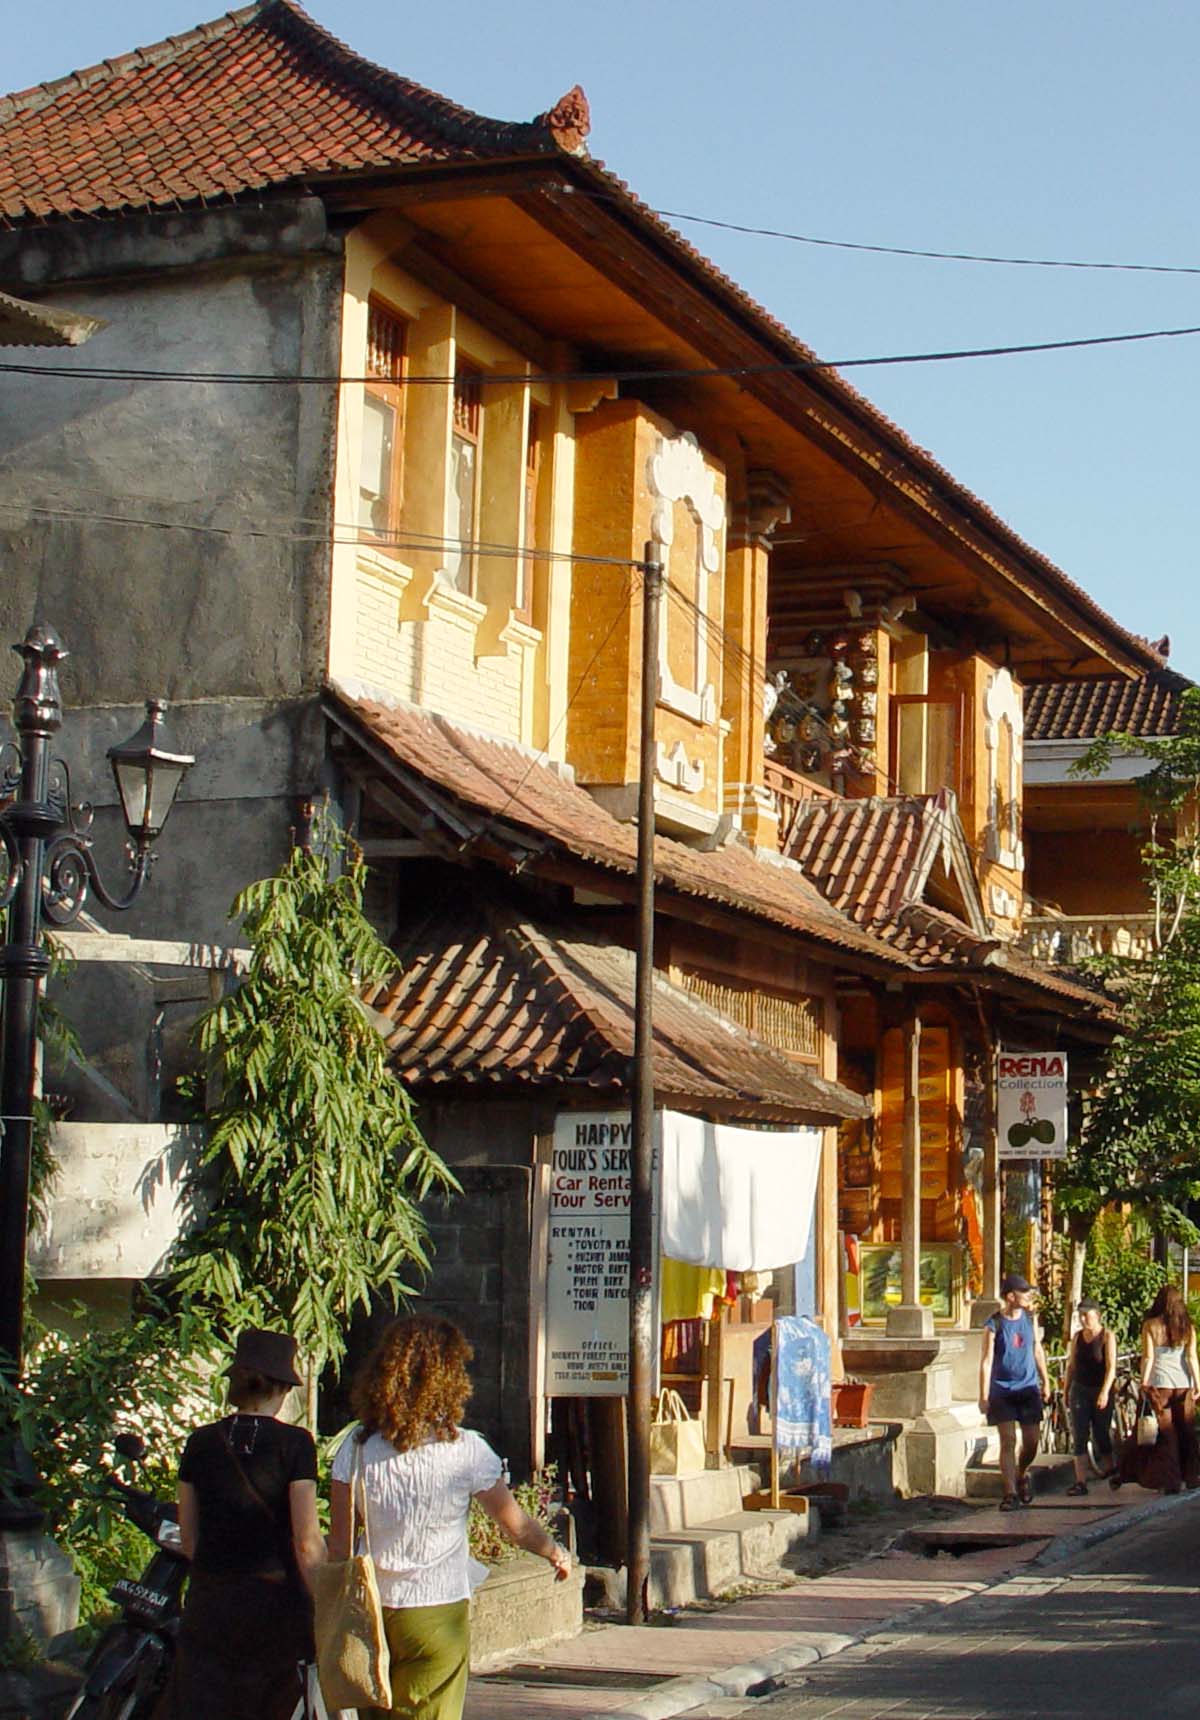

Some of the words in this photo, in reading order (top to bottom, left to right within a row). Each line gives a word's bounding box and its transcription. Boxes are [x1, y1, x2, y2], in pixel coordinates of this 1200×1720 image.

[999, 1056, 1065, 1077] RENA
[999, 1080, 1064, 1089] Collection
[576, 1123, 631, 1145] HAPPY
[552, 1148, 597, 1171] TOUR'S
[556, 1176, 582, 1191] Car
[588, 1176, 632, 1191] Renta
[552, 1193, 586, 1208] Tour
[594, 1193, 631, 1208] Serv
[576, 1240, 611, 1249] TOYOTA
[574, 1264, 604, 1274] MOTOR
[608, 1264, 628, 1274] BIKE
[573, 1288, 599, 1298] TOUR
